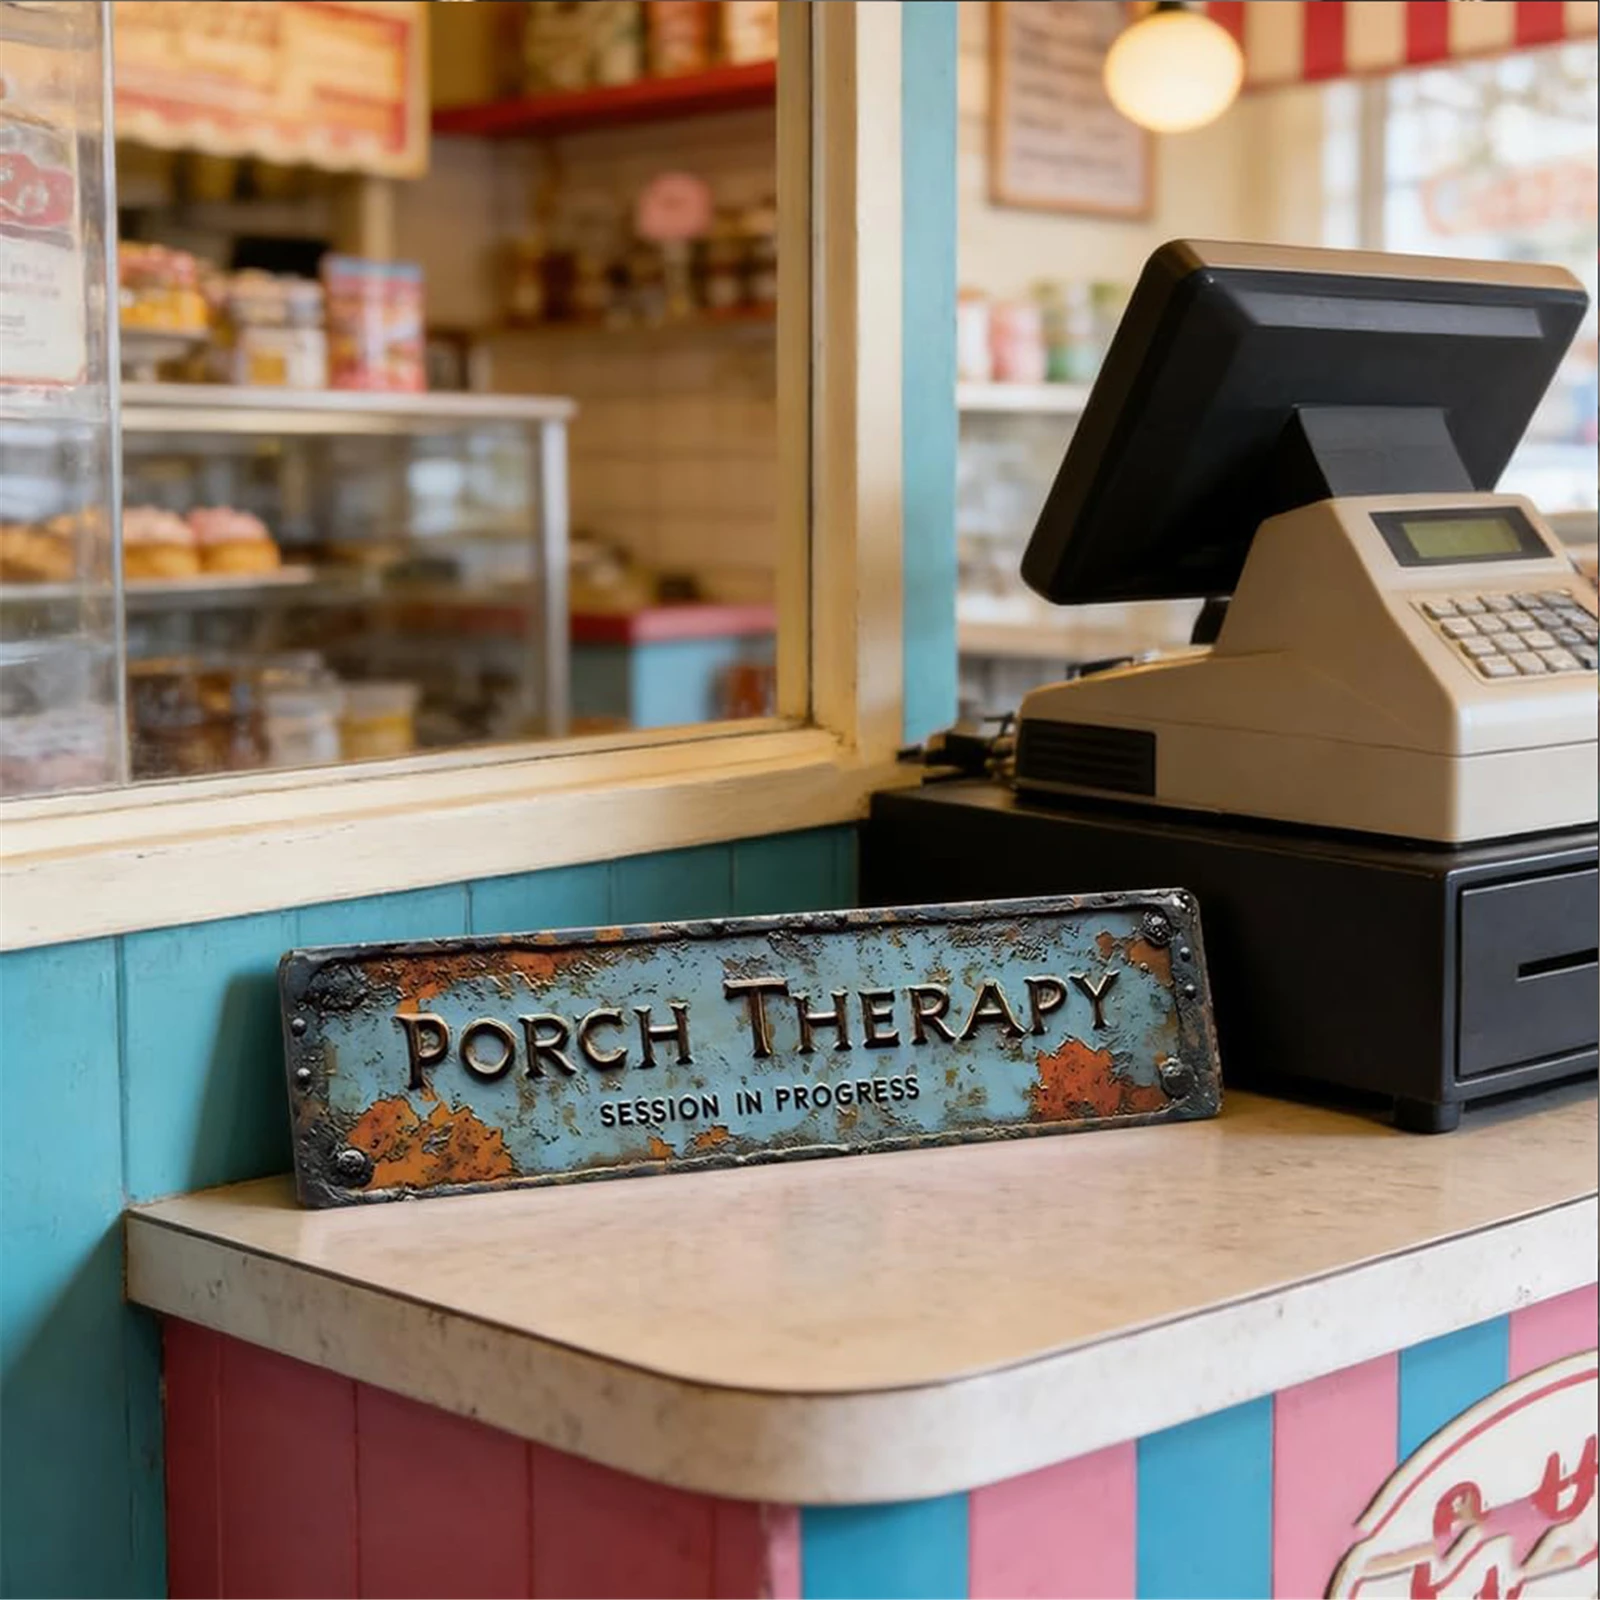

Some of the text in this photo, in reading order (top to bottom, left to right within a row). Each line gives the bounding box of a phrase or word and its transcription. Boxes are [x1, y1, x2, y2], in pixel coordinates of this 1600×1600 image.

[394, 970, 1121, 1091] PORCH THERAPY
[600, 1074, 921, 1128] SESSION IN PROGRESS
